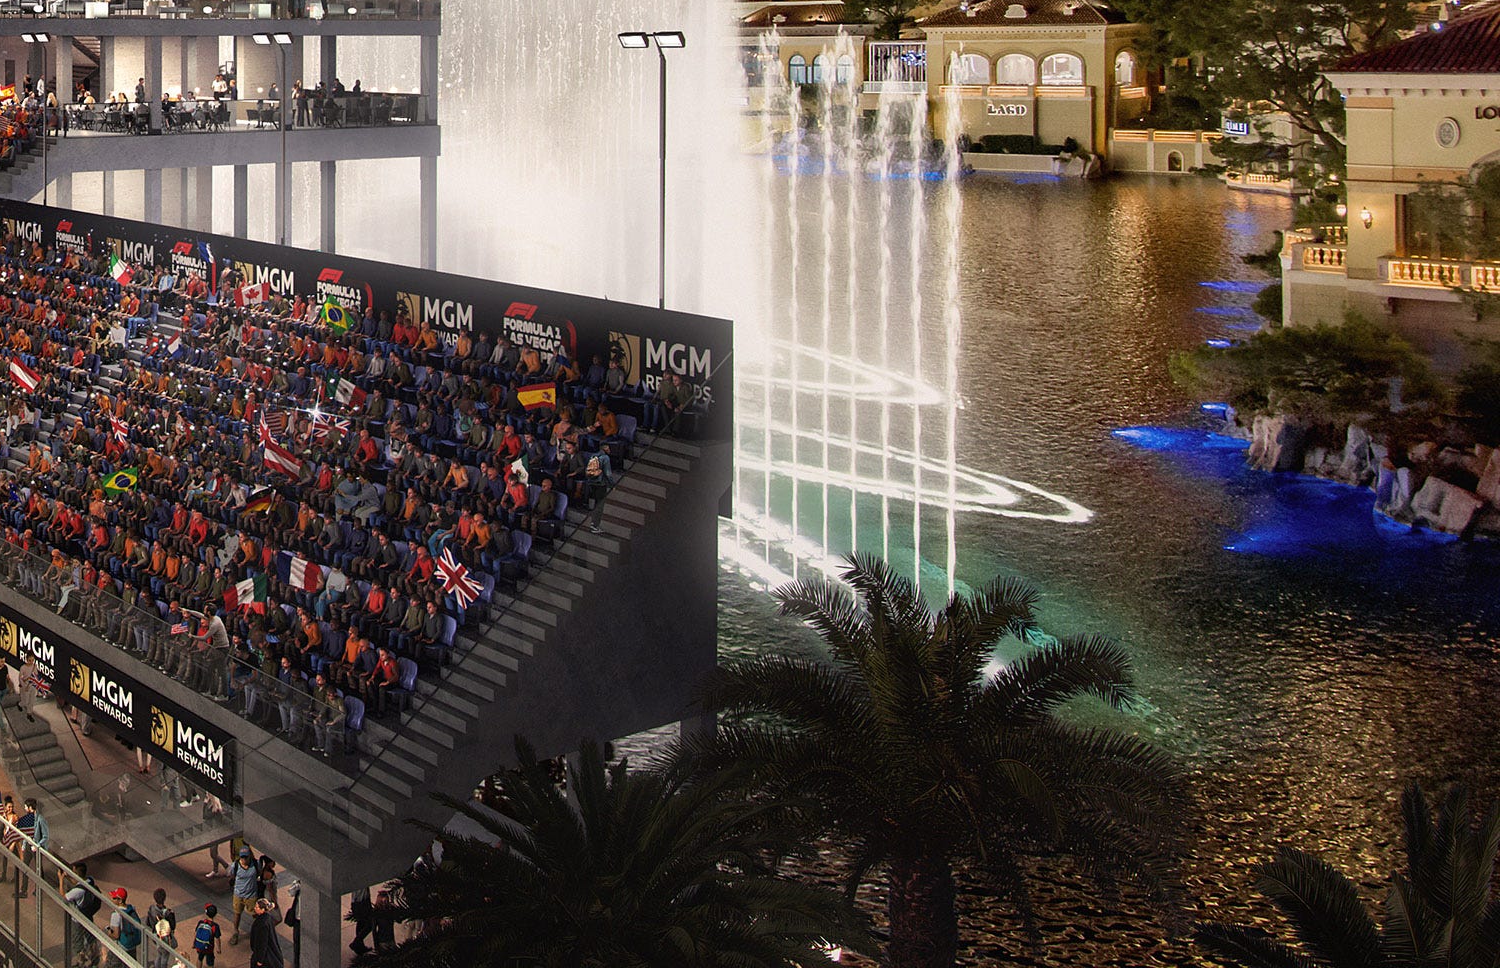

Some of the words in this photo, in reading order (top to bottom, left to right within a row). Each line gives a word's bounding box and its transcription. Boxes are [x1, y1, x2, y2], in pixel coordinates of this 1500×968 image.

[987, 103, 1027, 116] LAGO
[1475, 106, 1500, 119] LO
[16, 220, 42, 243] MGM
[123, 240, 154, 266] MGM
[171, 253, 202, 269] FORMULA
[256, 264, 294, 295] MGM
[317, 281, 356, 298] FORMULA
[356, 288, 361, 301] 1
[424, 296, 473, 331] MGM
[503, 317, 554, 338] FORMULA
[554, 327, 562, 340] 1
[645, 337, 711, 380] MGM
[19, 627, 55, 667] MGM
[92, 670, 133, 714] MGM
[177, 720, 224, 770] MGM
